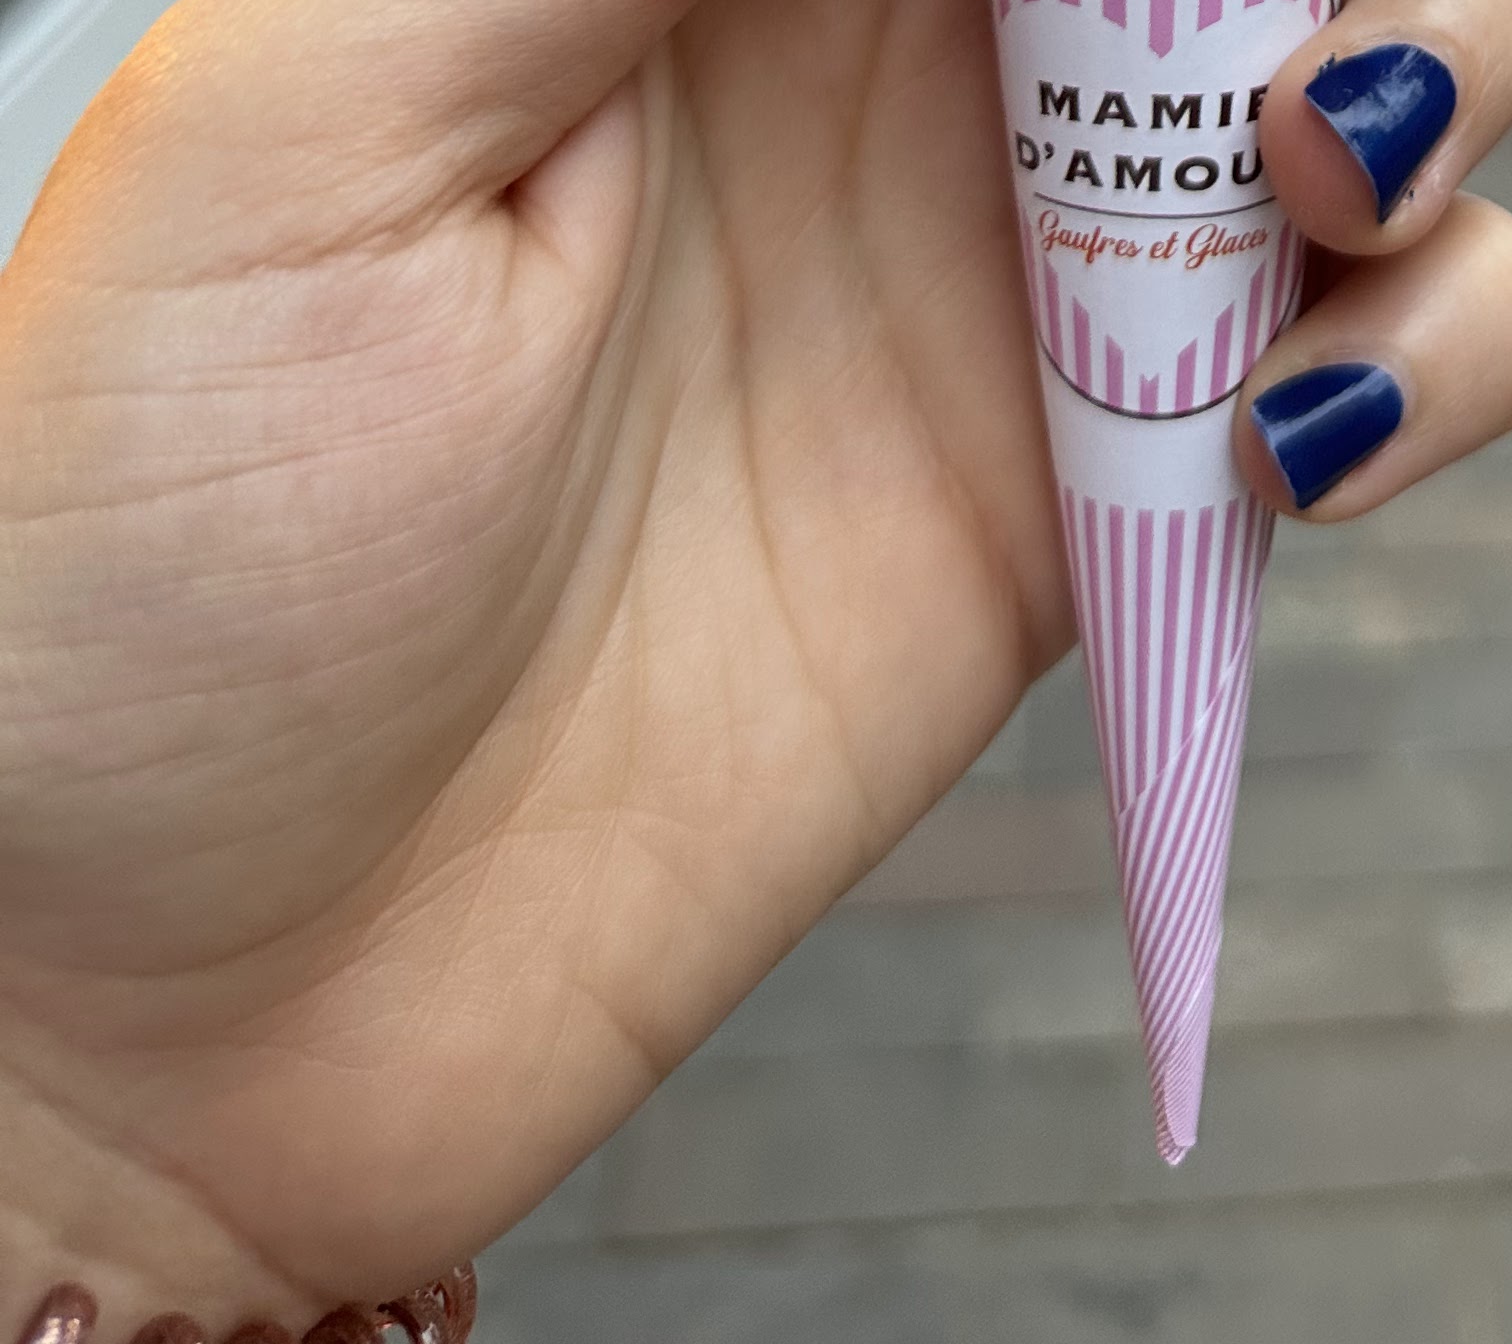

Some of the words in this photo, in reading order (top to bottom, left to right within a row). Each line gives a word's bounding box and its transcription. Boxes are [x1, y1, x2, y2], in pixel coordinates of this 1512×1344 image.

[1014, 130, 1264, 193] D'AMOU
[1038, 209, 1145, 264] Gaufres
[1149, 231, 1180, 260] et
[1184, 223, 1270, 270] Glaces
